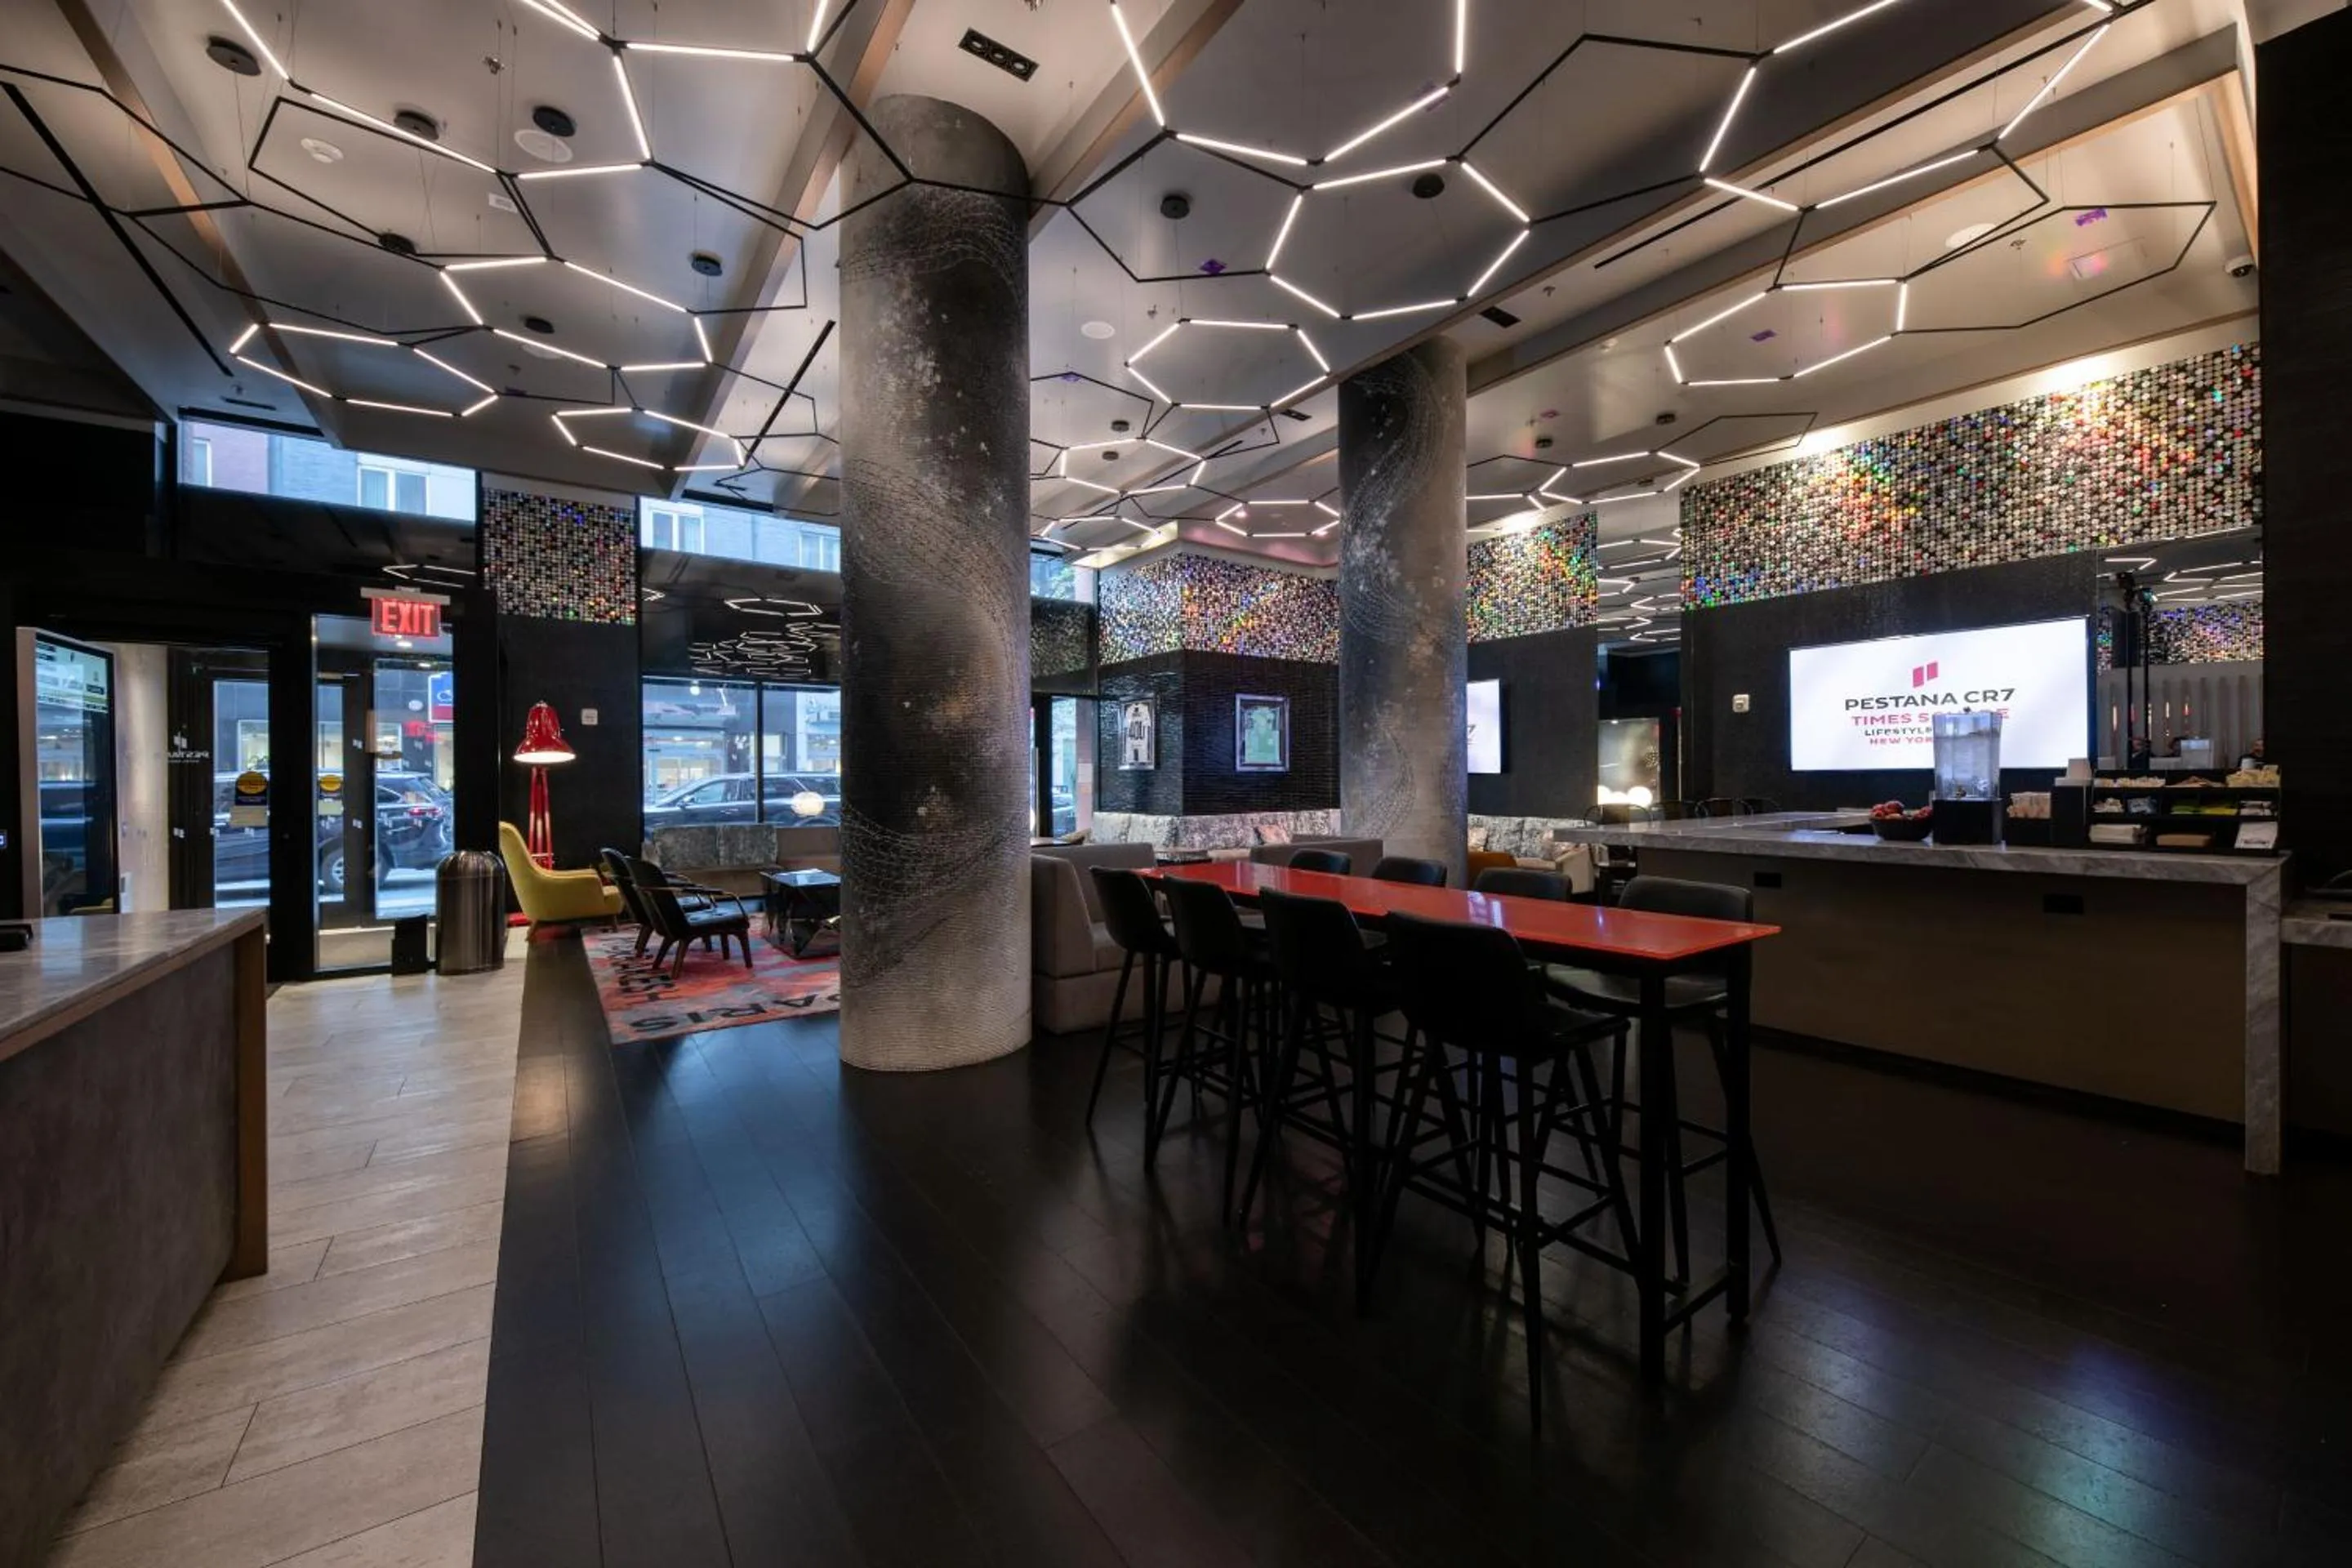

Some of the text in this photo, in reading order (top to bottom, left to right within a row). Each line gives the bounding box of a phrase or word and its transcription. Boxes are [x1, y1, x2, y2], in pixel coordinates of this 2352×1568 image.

[381, 600, 434, 635] EXIT
[1845, 688, 2016, 710] PESTANA CR7
[1851, 713, 1912, 726] TIMES
[1864, 726, 1932, 737] LIFESTYLE
[1869, 736, 1933, 745] NEW YOR
